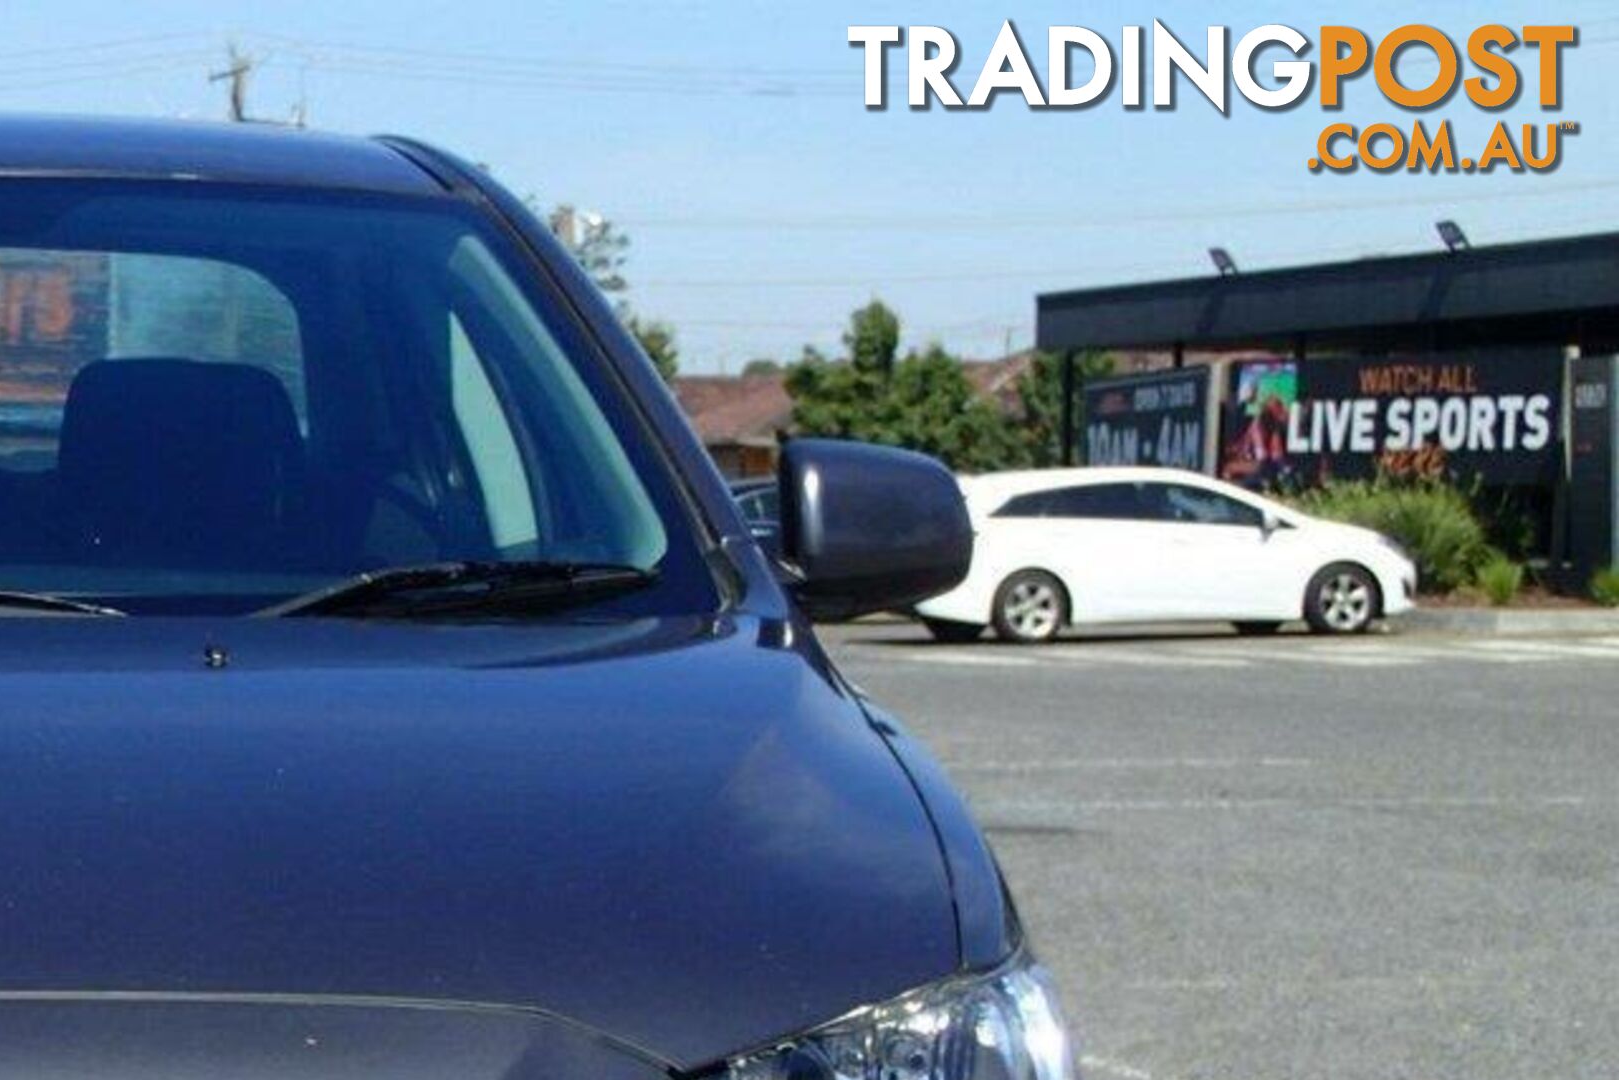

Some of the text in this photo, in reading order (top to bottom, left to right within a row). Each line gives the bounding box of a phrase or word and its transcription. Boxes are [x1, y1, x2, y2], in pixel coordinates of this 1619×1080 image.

[1358, 364, 1479, 394] WATCH ALL
[1286, 399, 1378, 453] LIVE
[1385, 395, 1551, 452] SPORTS
